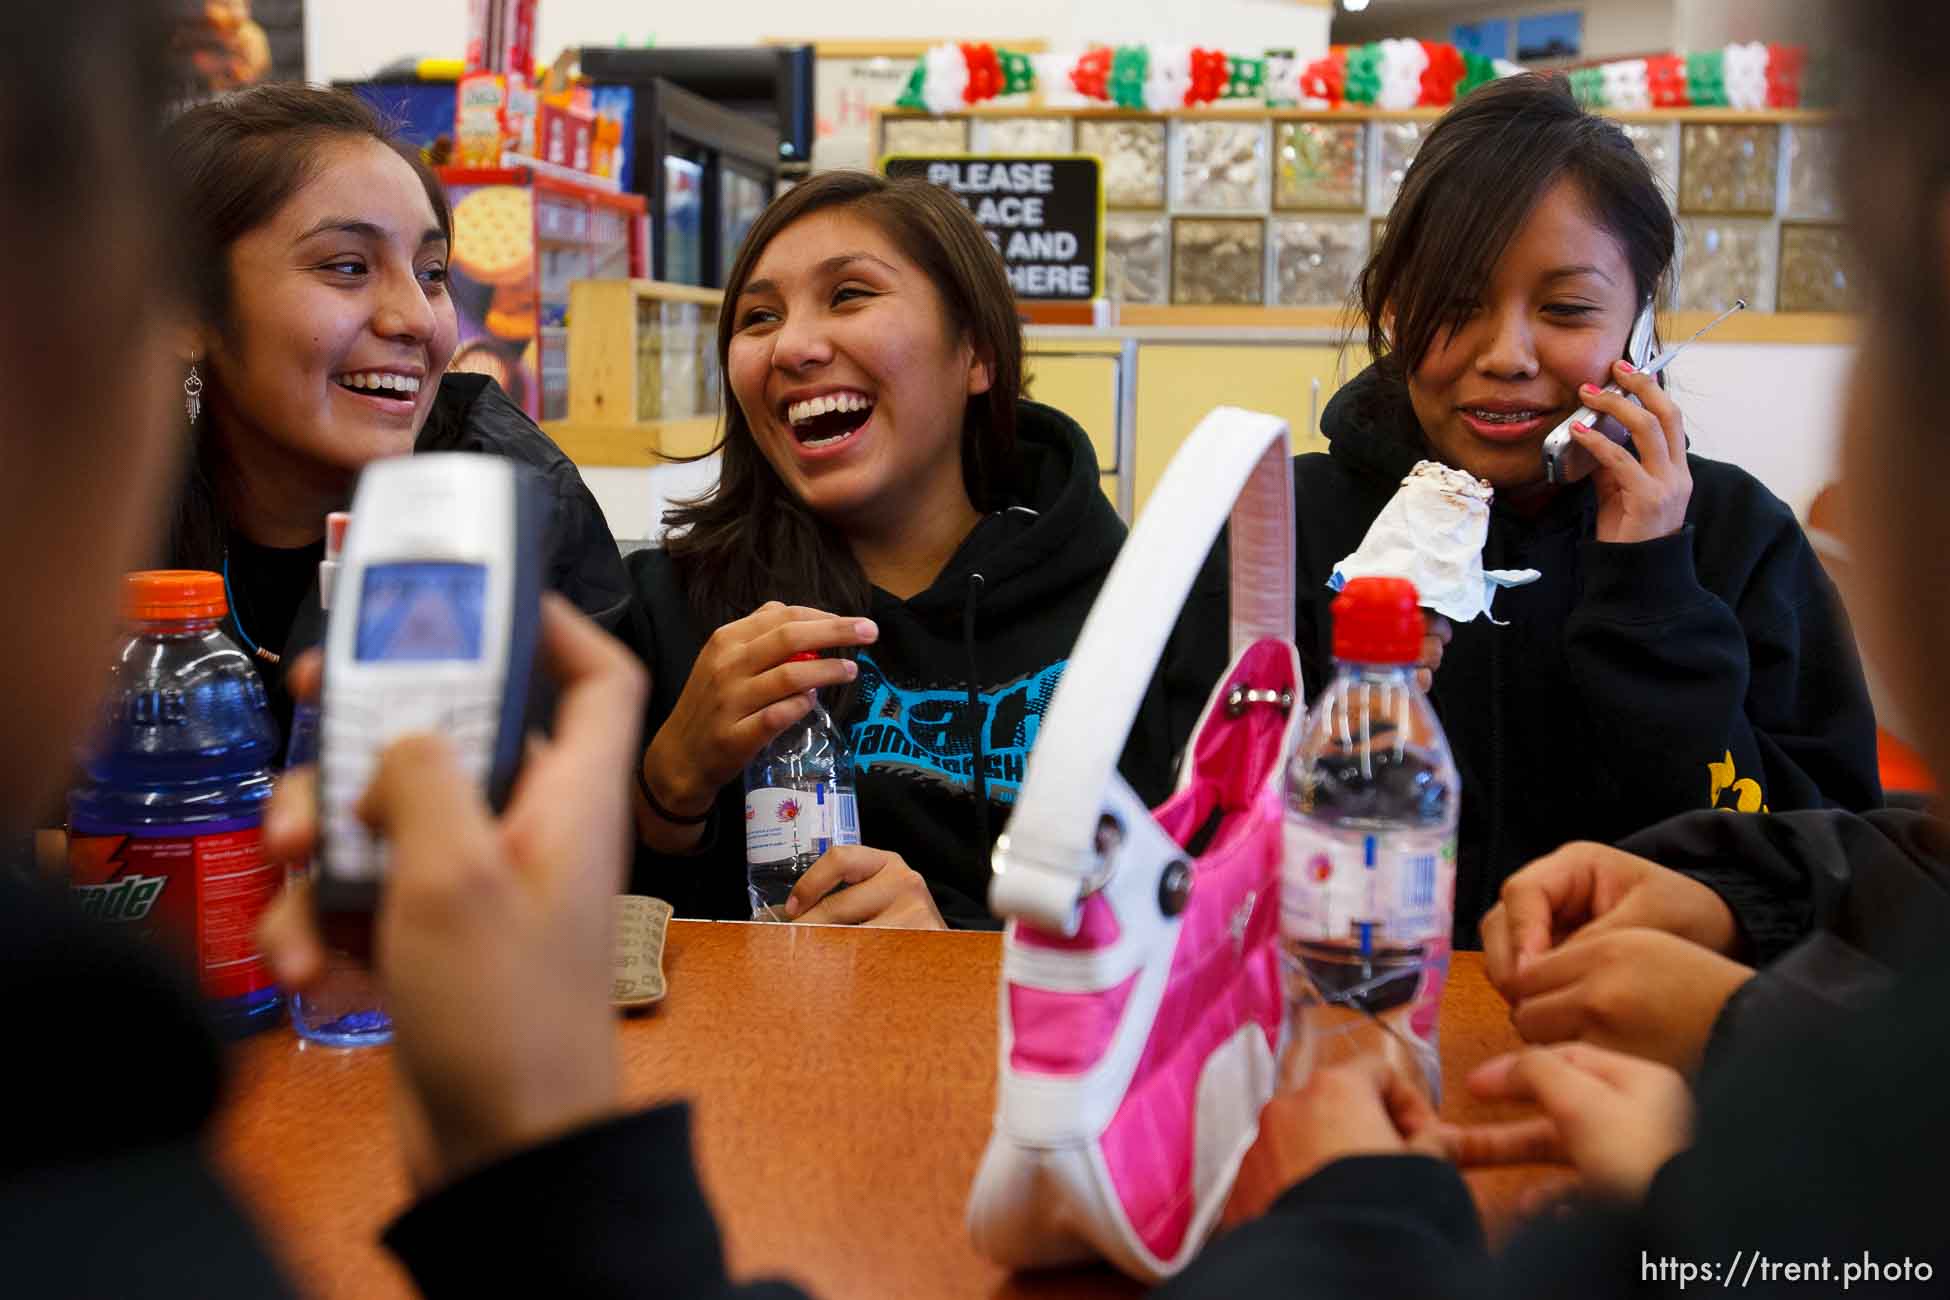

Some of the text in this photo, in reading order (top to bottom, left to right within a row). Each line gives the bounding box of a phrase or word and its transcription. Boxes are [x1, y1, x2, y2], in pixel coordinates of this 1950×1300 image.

[928, 163, 1054, 192] PLEASE
[962, 197, 1044, 226] ACE
[1006, 232, 1078, 261] AND
